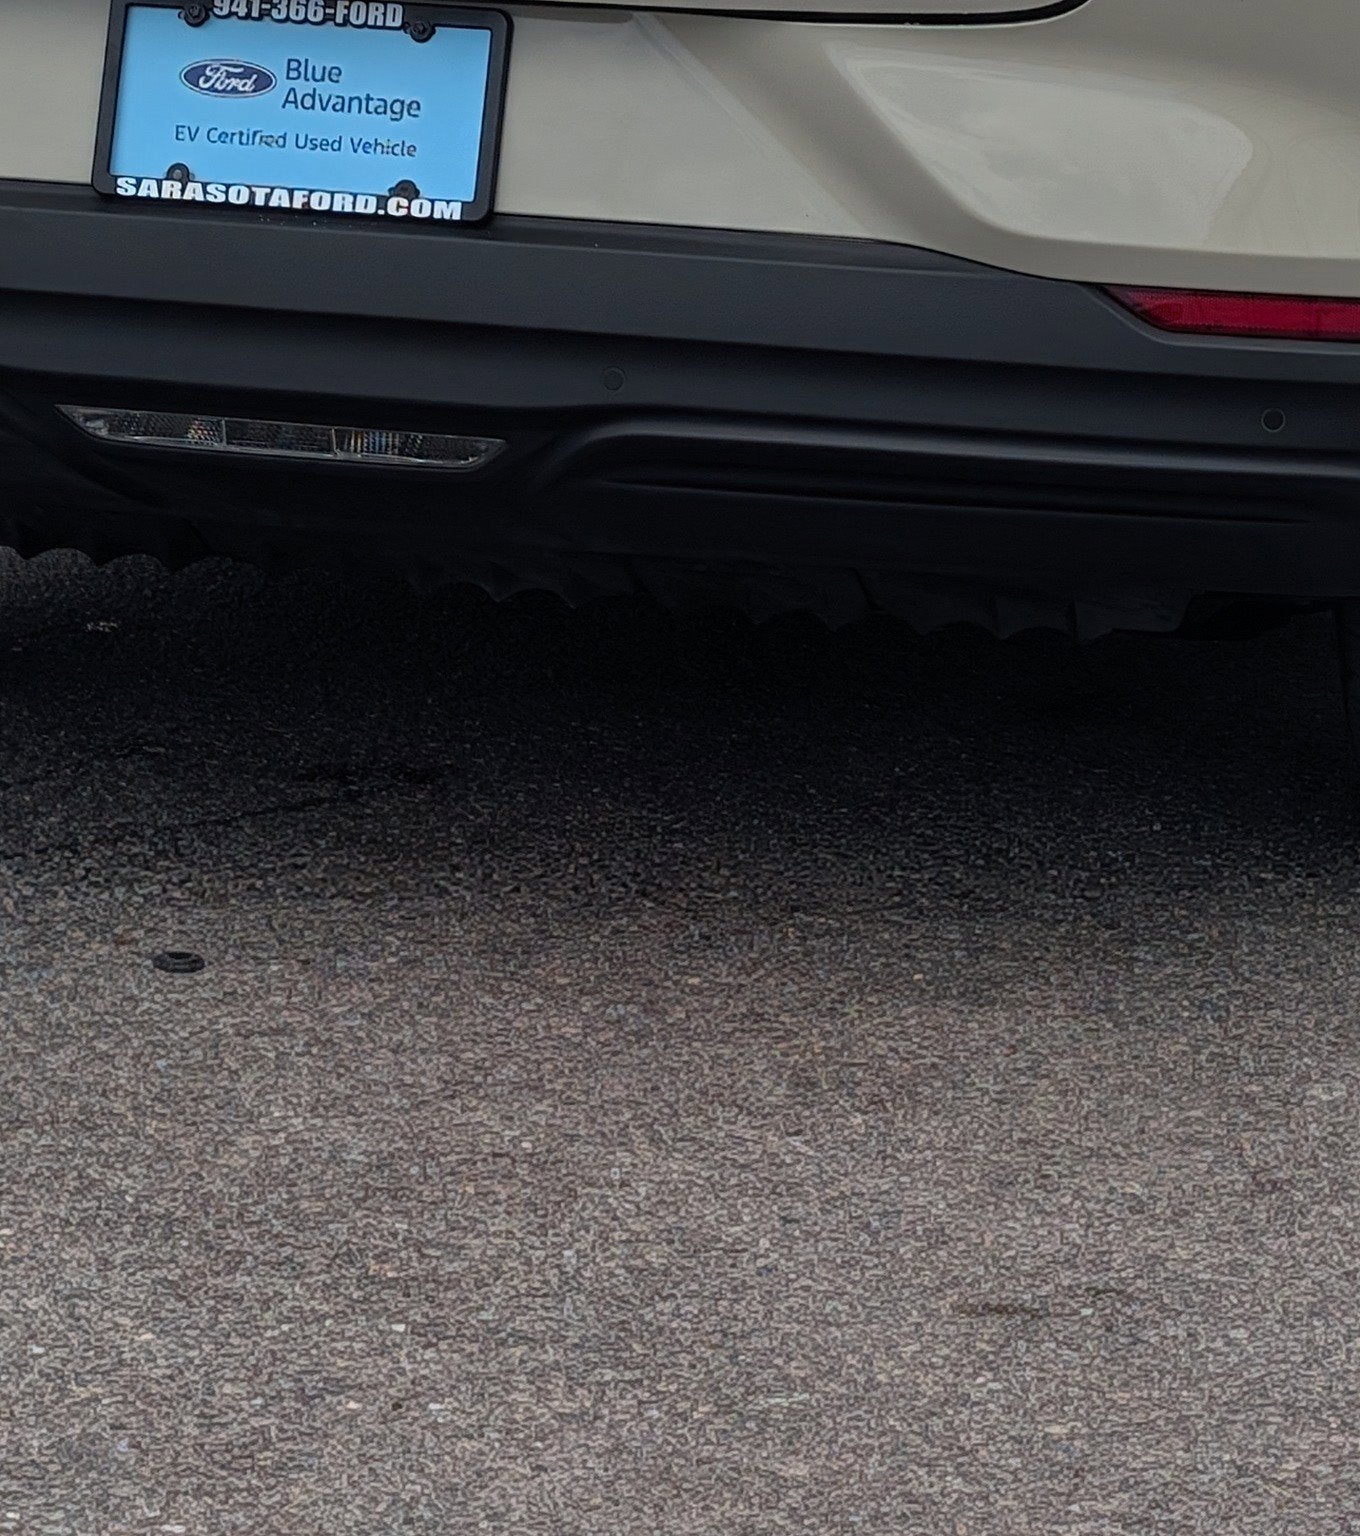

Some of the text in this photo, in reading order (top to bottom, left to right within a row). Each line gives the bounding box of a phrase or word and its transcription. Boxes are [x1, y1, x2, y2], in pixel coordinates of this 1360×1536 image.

[198, 64, 257, 92] Ford
[286, 58, 343, 83] Blue
[282, 87, 422, 122] Advantage
[175, 124, 418, 157] EV Certified Used Vehicle
[115, 176, 464, 221] SARASOTAFORD.COM
